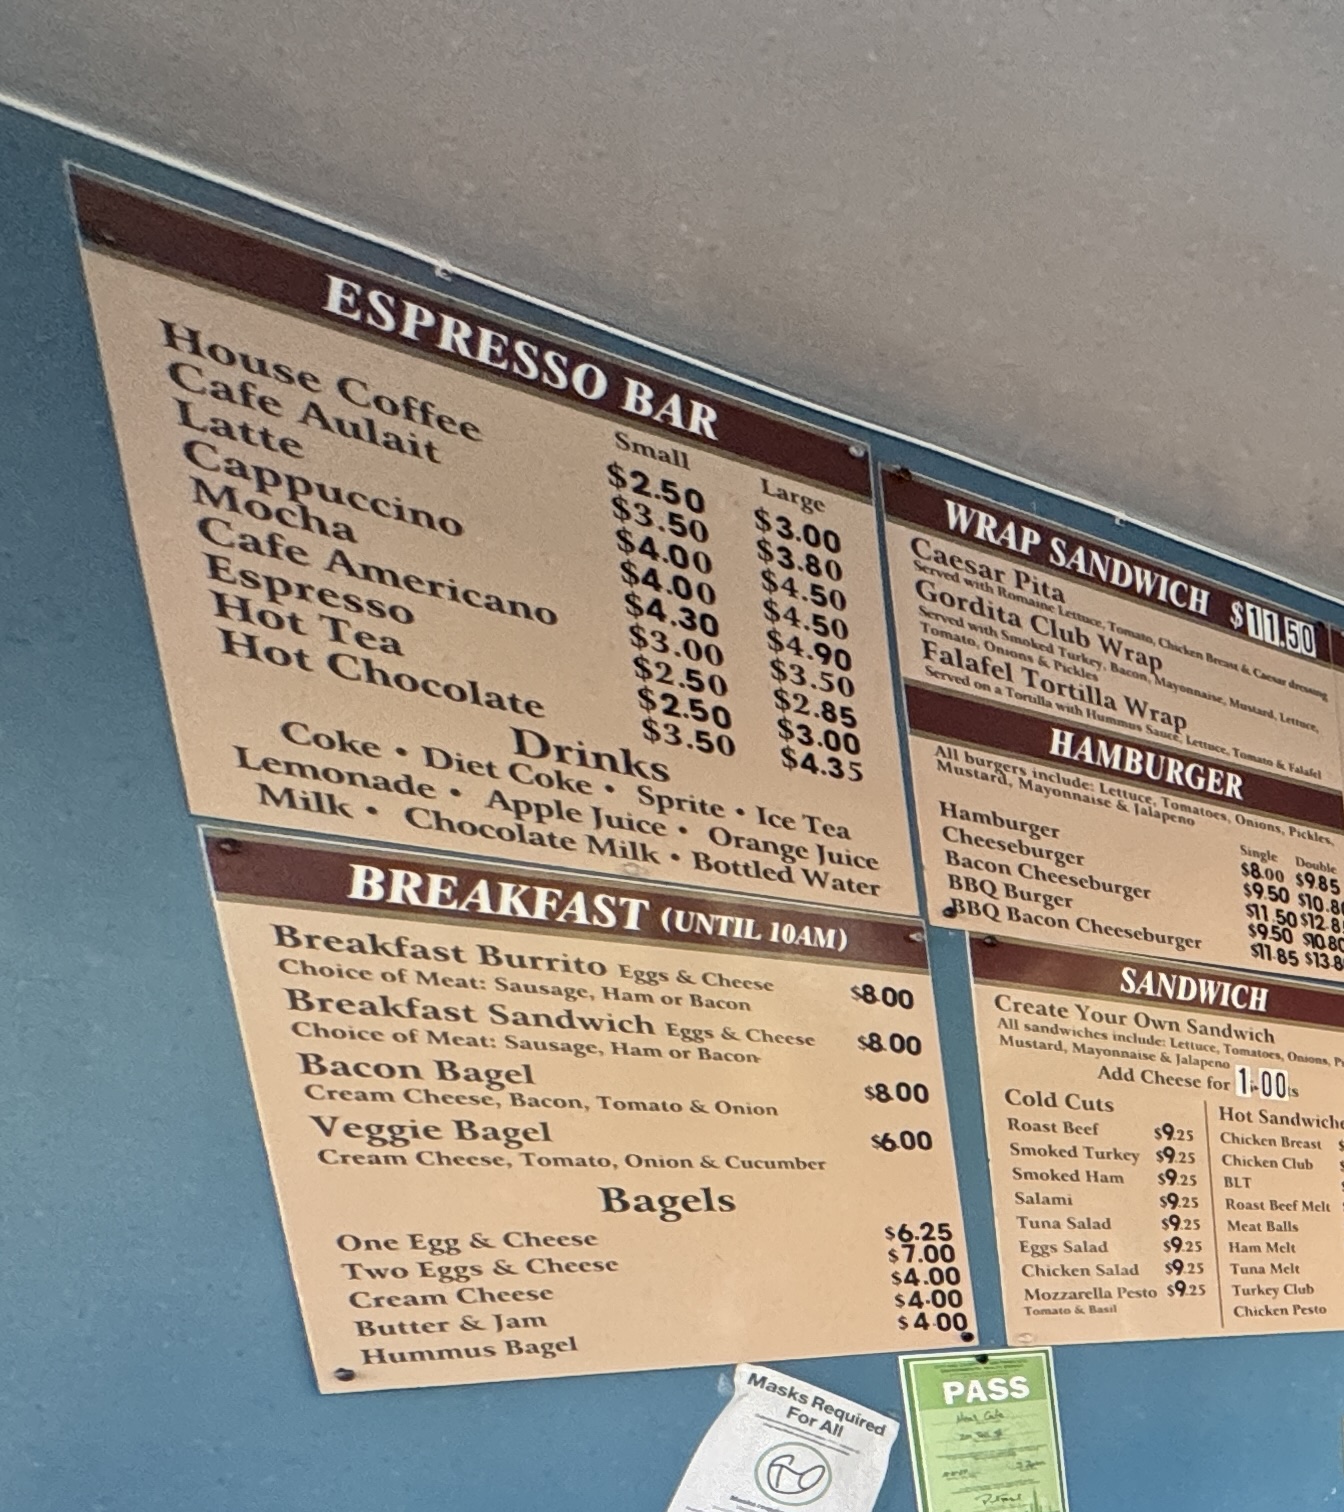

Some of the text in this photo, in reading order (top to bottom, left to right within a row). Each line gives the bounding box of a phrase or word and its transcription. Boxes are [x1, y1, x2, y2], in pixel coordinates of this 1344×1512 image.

[322, 273, 718, 440] ESPRESSO BAR
[158, 318, 841, 554] House Coffee $2.50 $3.00
[166, 361, 843, 581] Cafe Aulait $3.50 $3.80
[172, 396, 847, 611] Latte $4.00 $4.50
[614, 430, 826, 515] Small Large
[182, 439, 849, 640] Cappuccino $4.00 $4.50
[909, 536, 1065, 604] Caesar Pita
[188, 475, 852, 672] Mocha $4.30 $4.90
[944, 498, 1316, 657] WRAP SANDWICH $11.50
[202, 551, 857, 729] Espresso $2.50 $2.85
[914, 578, 1163, 672] Gordita Club Wrap
[216, 626, 863, 782] Hot Chocolate $3.50 $4.35
[280, 720, 851, 840] Coke Diet Coke Sprite Ice Tea
[509, 725, 670, 782] Drinks
[933, 744, 959, 761] All
[963, 750, 1027, 776] burgers
[1048, 727, 1242, 800] HAMBURGER
[232, 744, 878, 871] Lemonade Apple Juice Orange Juice
[938, 799, 1341, 895] Hamburger $8.00 $9.85
[941, 825, 1085, 868] Cheeseburger
[1242, 881, 1290, 904] $9.50
[1239, 843, 1337, 874] Single Double
[346, 863, 847, 952] BREAKFAST (UNTIL 10AM)
[270, 923, 914, 1009] Breakfast Burrito Eggs & Cheese $8.00
[277, 957, 372, 981] Choice
[380, 967, 407, 983] of
[600, 985, 654, 1004] Ham
[659, 994, 683, 1006] or
[688, 993, 751, 1011] Bacon
[1119, 966, 1268, 1012] SANDWICH
[993, 993, 1275, 1044] Create Your Own Sandwich
[296, 1052, 929, 1104] Bacon Bagel $8.00
[303, 1083, 395, 1103] Cream
[595, 1094, 683, 1112] Tomato
[688, 1099, 709, 1114] &
[714, 1099, 778, 1116] Onion
[1004, 1088, 1114, 1112] Cold Cuts
[1006, 1116, 1193, 1141] Roast Beef $9.25
[1218, 1105, 1253, 1123] Hot
[1219, 1131, 1277, 1147] Chicken
[1280, 1135, 1322, 1150] Breast
[1009, 1141, 1195, 1165] Smoked Turkey $9.25
[1223, 1175, 1252, 1188] BLT
[597, 1186, 736, 1222] Bagels
[340, 1243, 955, 1283] Two Eggs & Cheese $7.00
[747, 1372, 808, 1405] Masks
[811, 1395, 888, 1437] Required
[786, 1405, 819, 1427] For
[818, 1419, 845, 1438] All
[942, 1375, 1030, 1405] PASS
